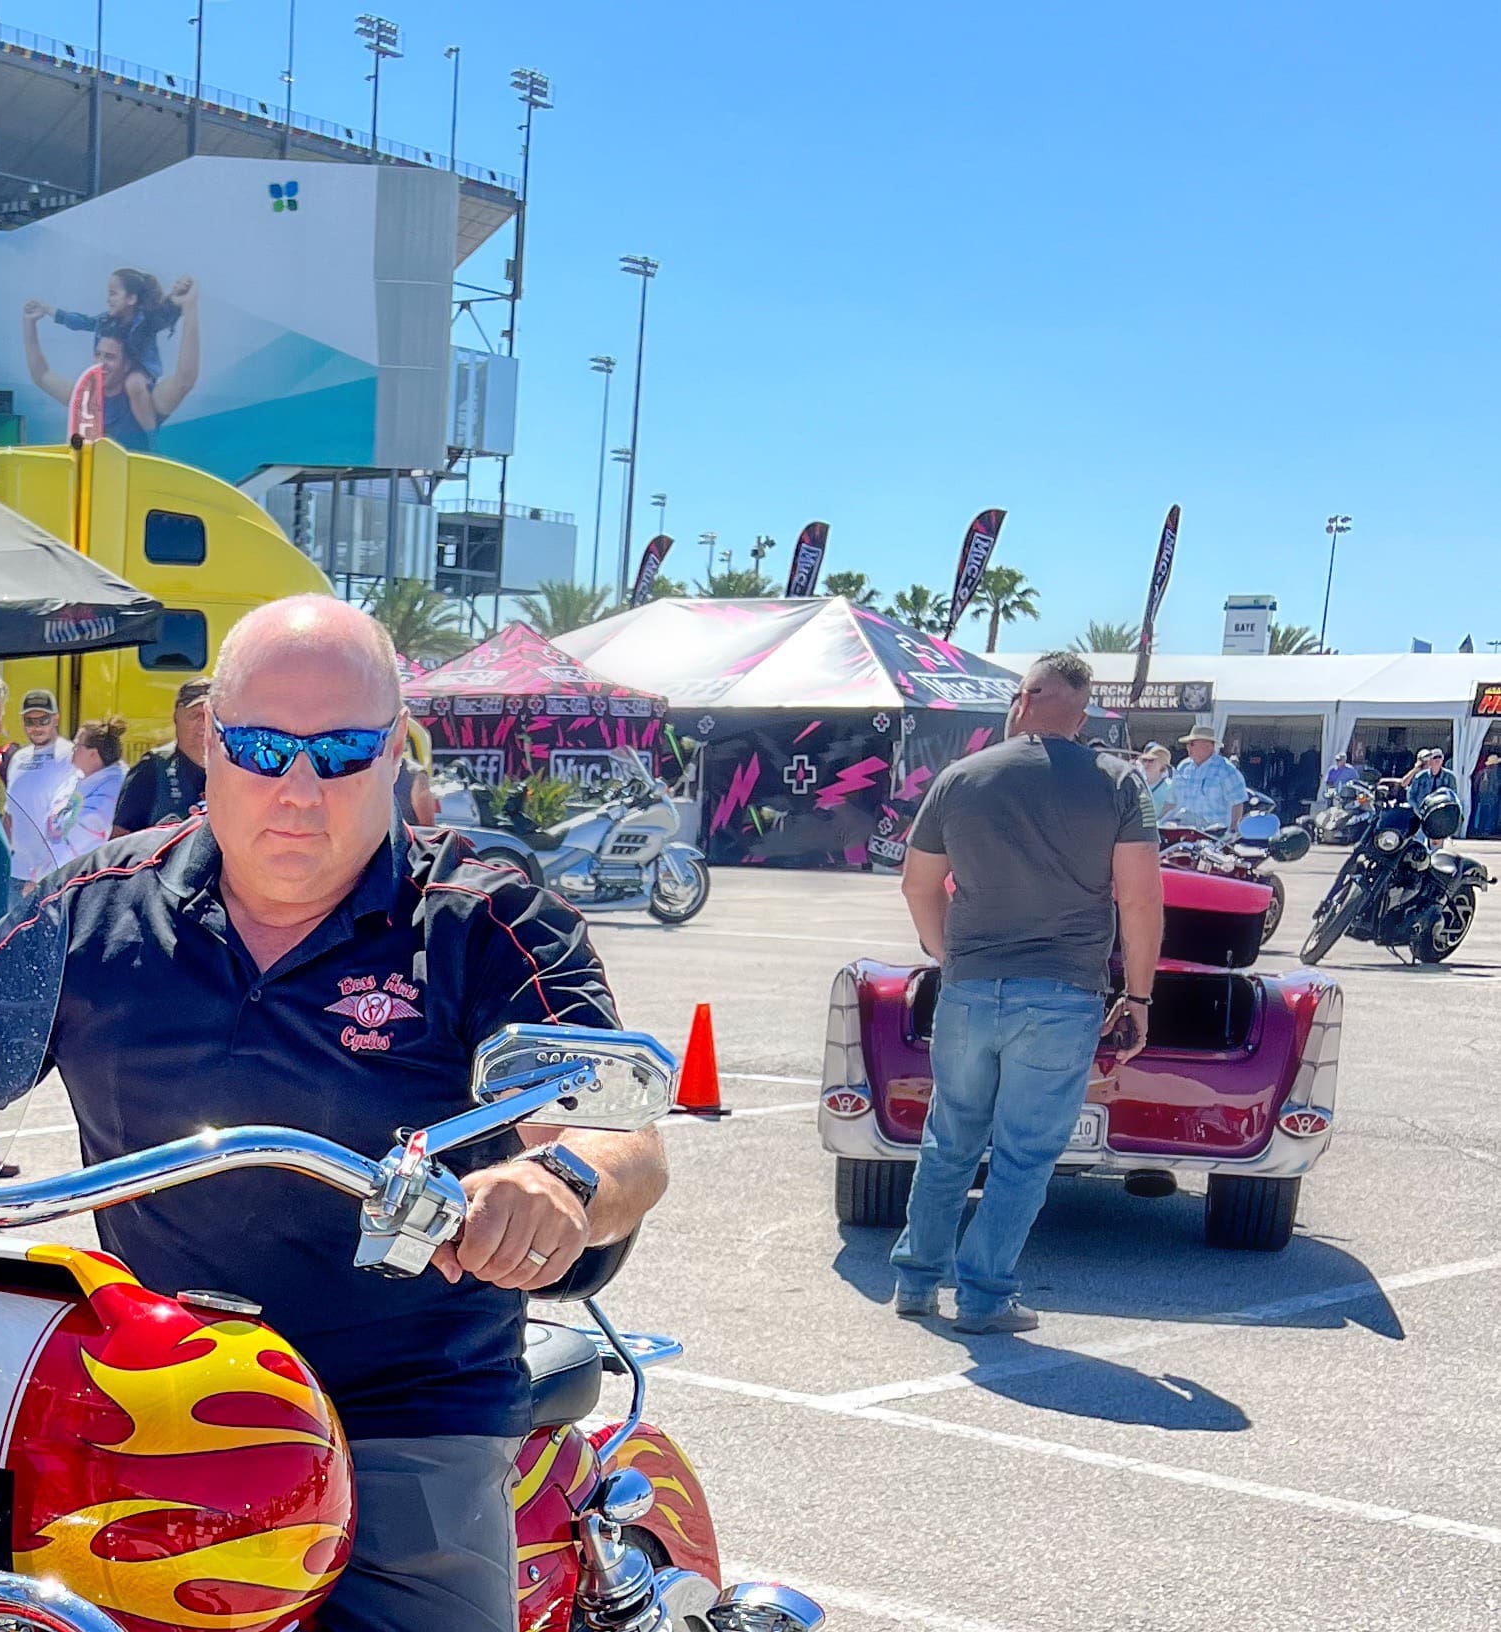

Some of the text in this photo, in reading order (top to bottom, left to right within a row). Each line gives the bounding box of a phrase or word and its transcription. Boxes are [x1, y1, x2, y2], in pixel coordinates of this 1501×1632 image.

[1234, 623, 1255, 632] GATE
[1102, 697, 1135, 708] BIK
[1139, 696, 1179, 708] WEEK
